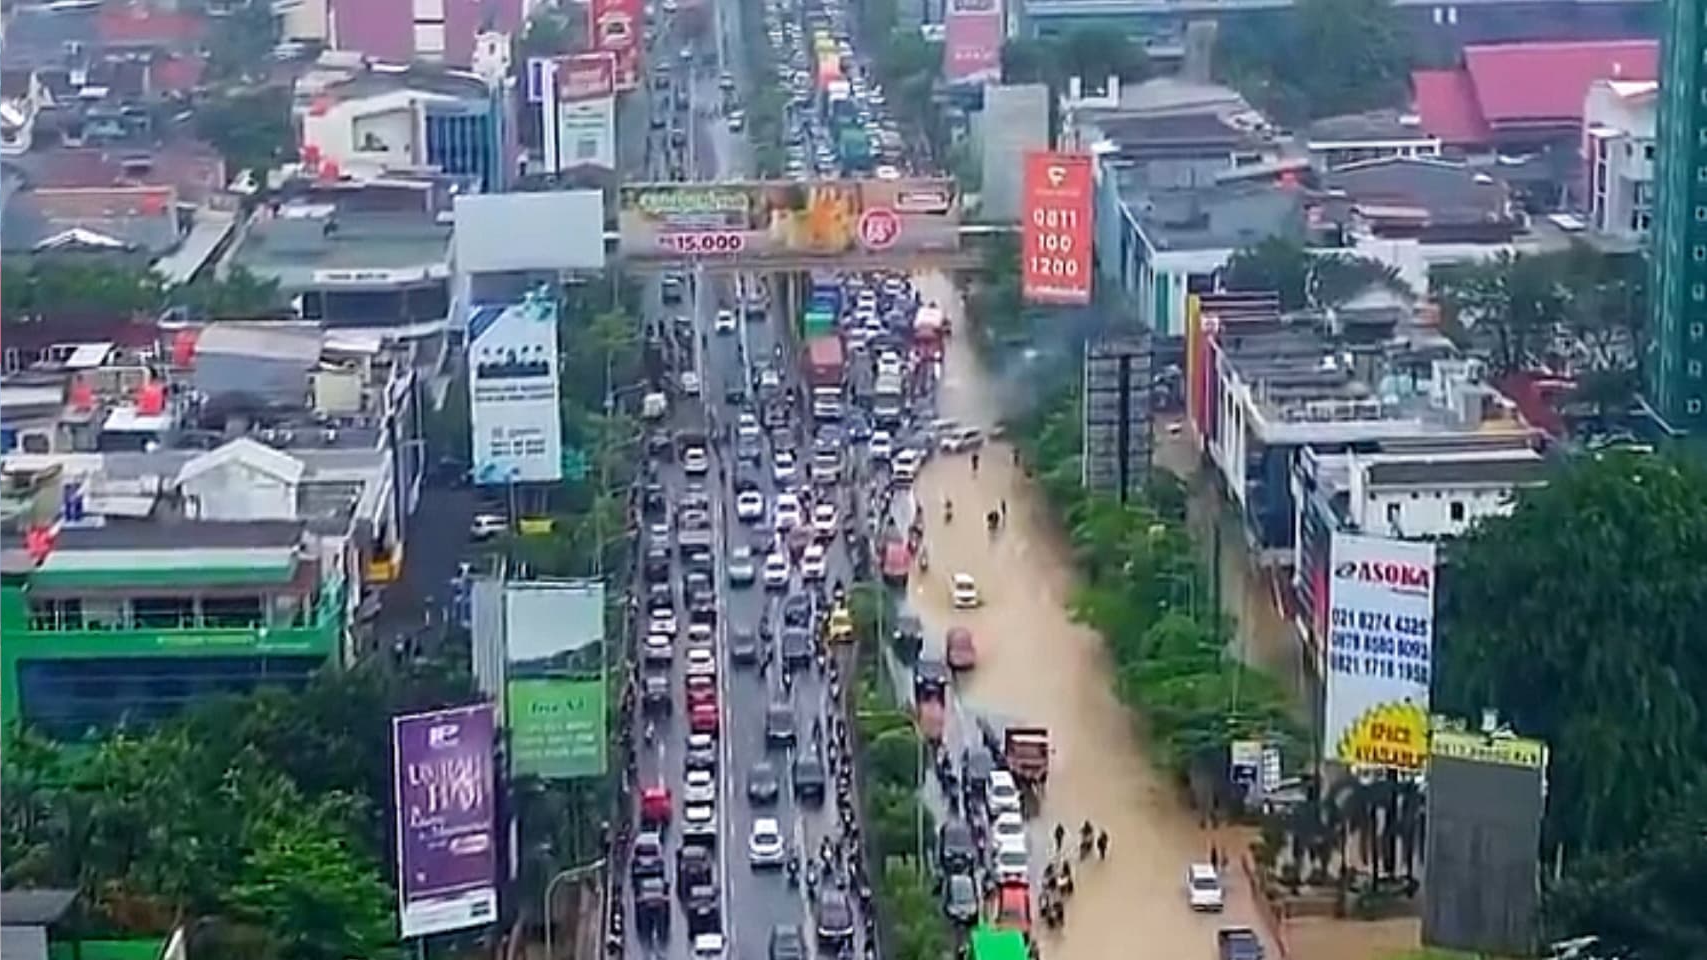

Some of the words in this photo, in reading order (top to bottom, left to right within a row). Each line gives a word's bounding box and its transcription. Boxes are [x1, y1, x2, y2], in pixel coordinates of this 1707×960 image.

[1033, 208, 1077, 228] 0811
[676, 235, 742, 251] 15.000
[1038, 233, 1072, 252] 100
[1030, 257, 1078, 277] 1200
[1358, 562, 1428, 589] ASOKA
